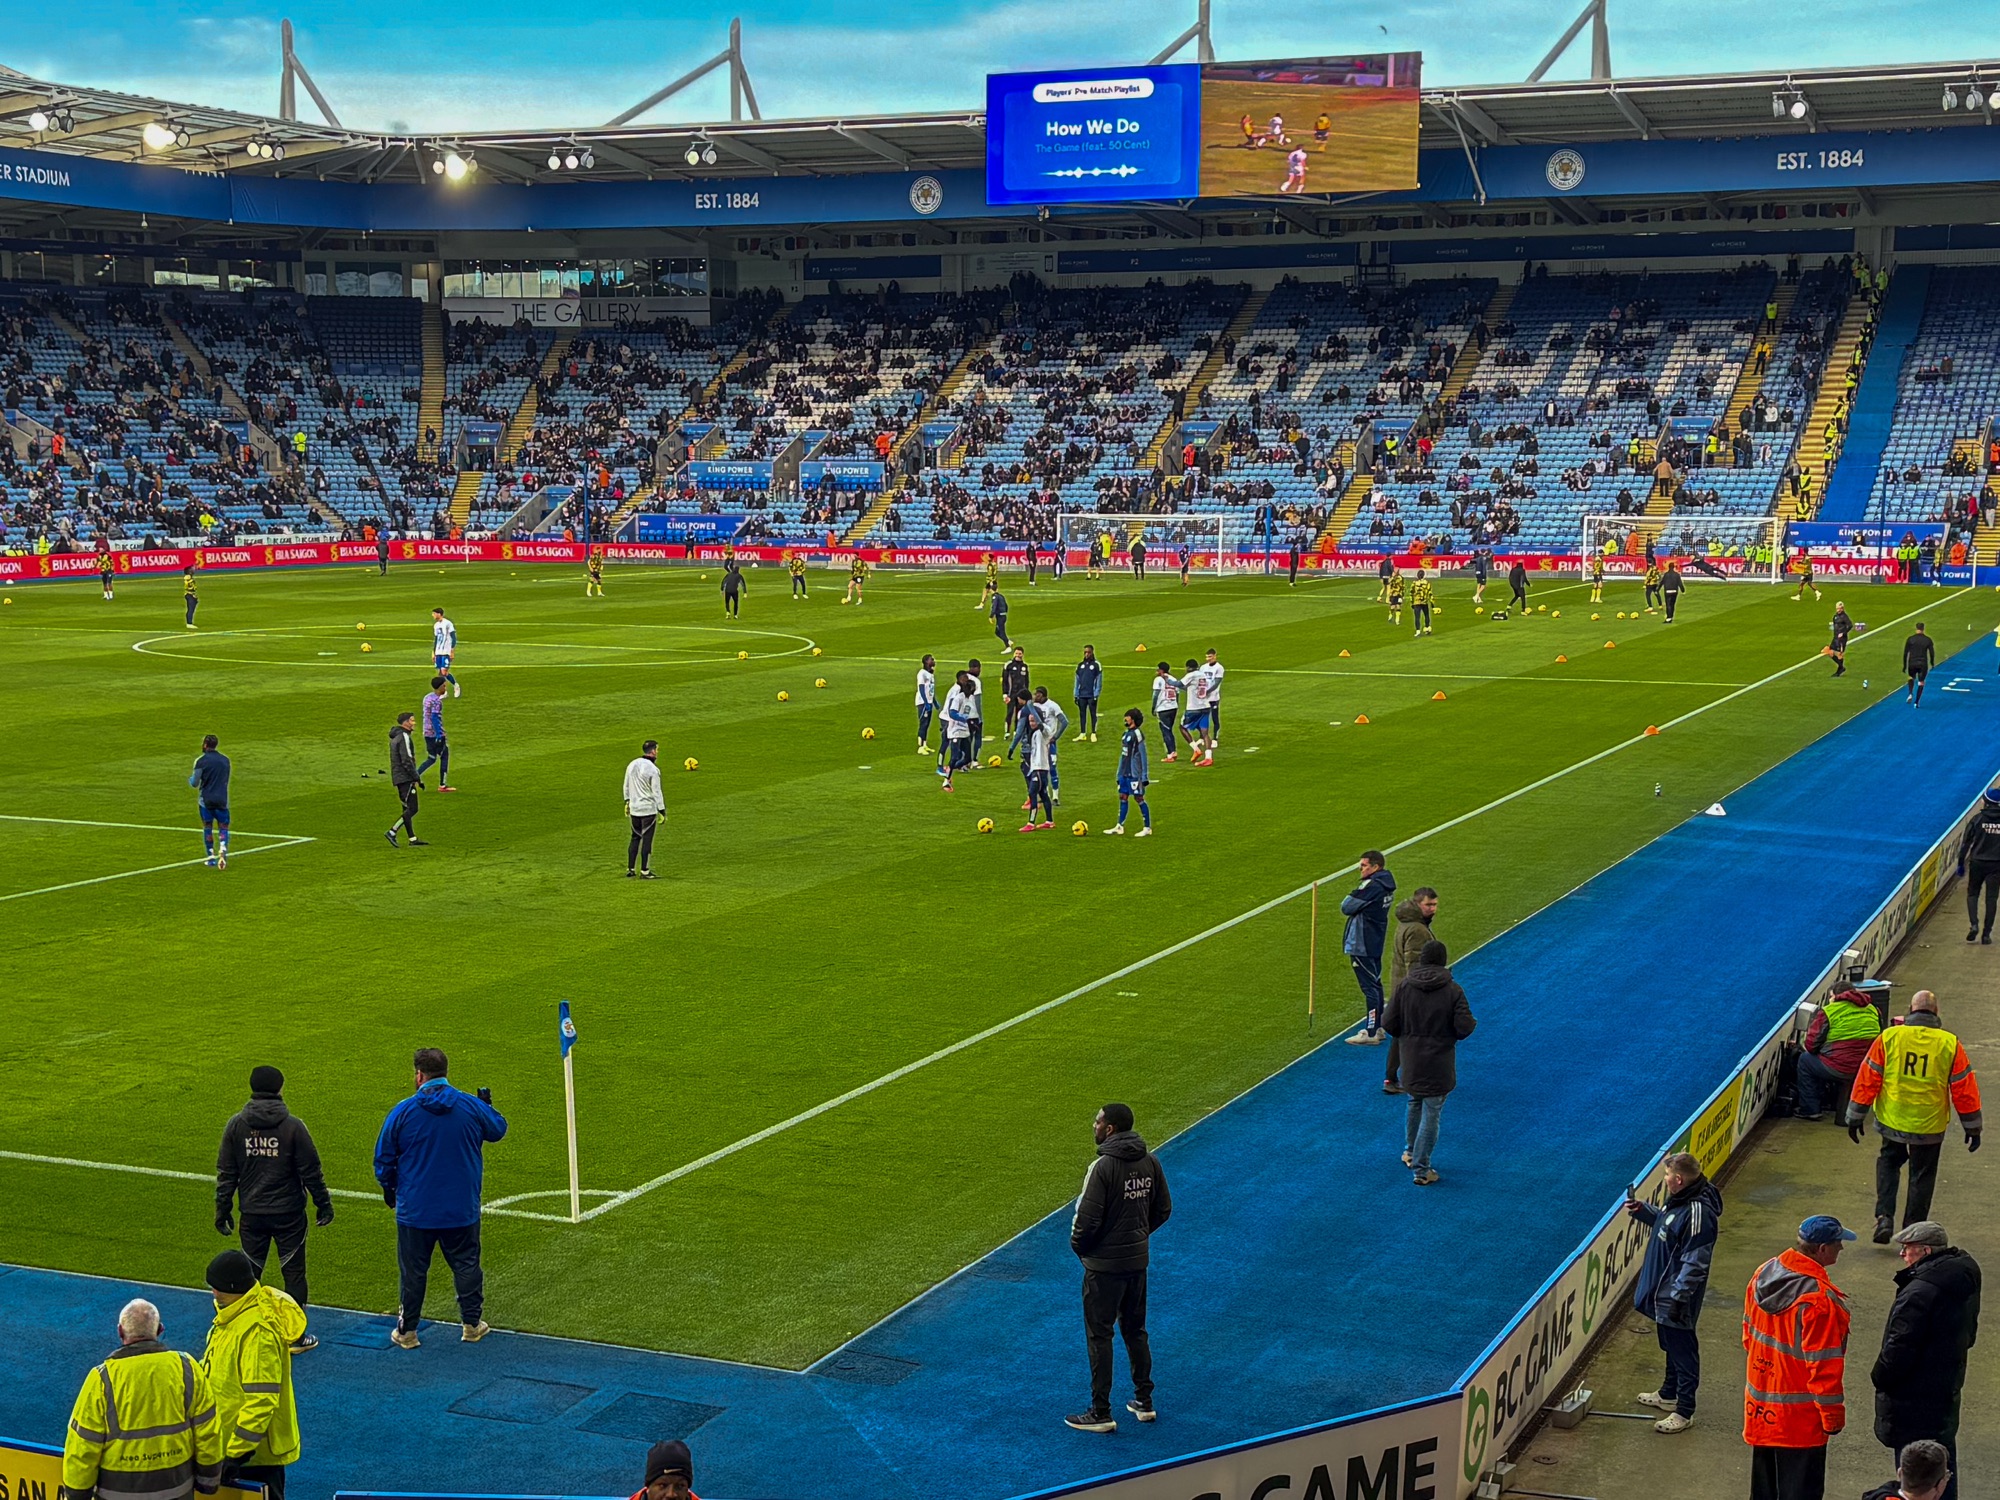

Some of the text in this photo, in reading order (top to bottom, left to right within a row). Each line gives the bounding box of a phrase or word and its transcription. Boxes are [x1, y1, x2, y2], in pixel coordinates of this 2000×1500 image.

[1114, 85, 1140, 94] Playlist
[1046, 118, 1140, 136] How We Do
[1035, 139, 1150, 153] The Game (feat. 50 Cent)
[1777, 149, 1864, 170] EST. 1884
[16, 166, 70, 187] STADIUM
[695, 192, 760, 209] EST. 1884
[511, 303, 641, 322] THE GALLERY
[688, 522, 716, 530] POWER
[275, 548, 318, 560] BIA SAIGON
[340, 546, 378, 557] BIA SAIGO
[419, 544, 482, 555] BIA SAIGON
[516, 546, 573, 557] BIA SAIGON
[607, 547, 666, 558] BIA SAIGON
[132, 554, 180, 567] BIA SAIGON
[206, 551, 251, 564] BIA SAIGON
[701, 550, 760, 561] BIA SIGON
[895, 554, 959, 564] BIA SAIGON
[997, 555, 1017, 565] BIA
[52, 556, 98, 570] BIA SAIGO
[1210, 558, 1233, 567] BA
[1322, 559, 1345, 569] BIA
[1438, 561, 1459, 571] BIA
[1558, 561, 1636, 572] BIA SIGON
[1812, 564, 1837, 574] BIA
[1903, 1051, 1929, 1078] R1
[1750, 1042, 1782, 1113] BC.GA
[245, 1137, 279, 1148] KING
[246, 1148, 279, 1157] POWER
[1124, 1177, 1152, 1192] KING
[1493, 1289, 1576, 1440] BC.GAME
